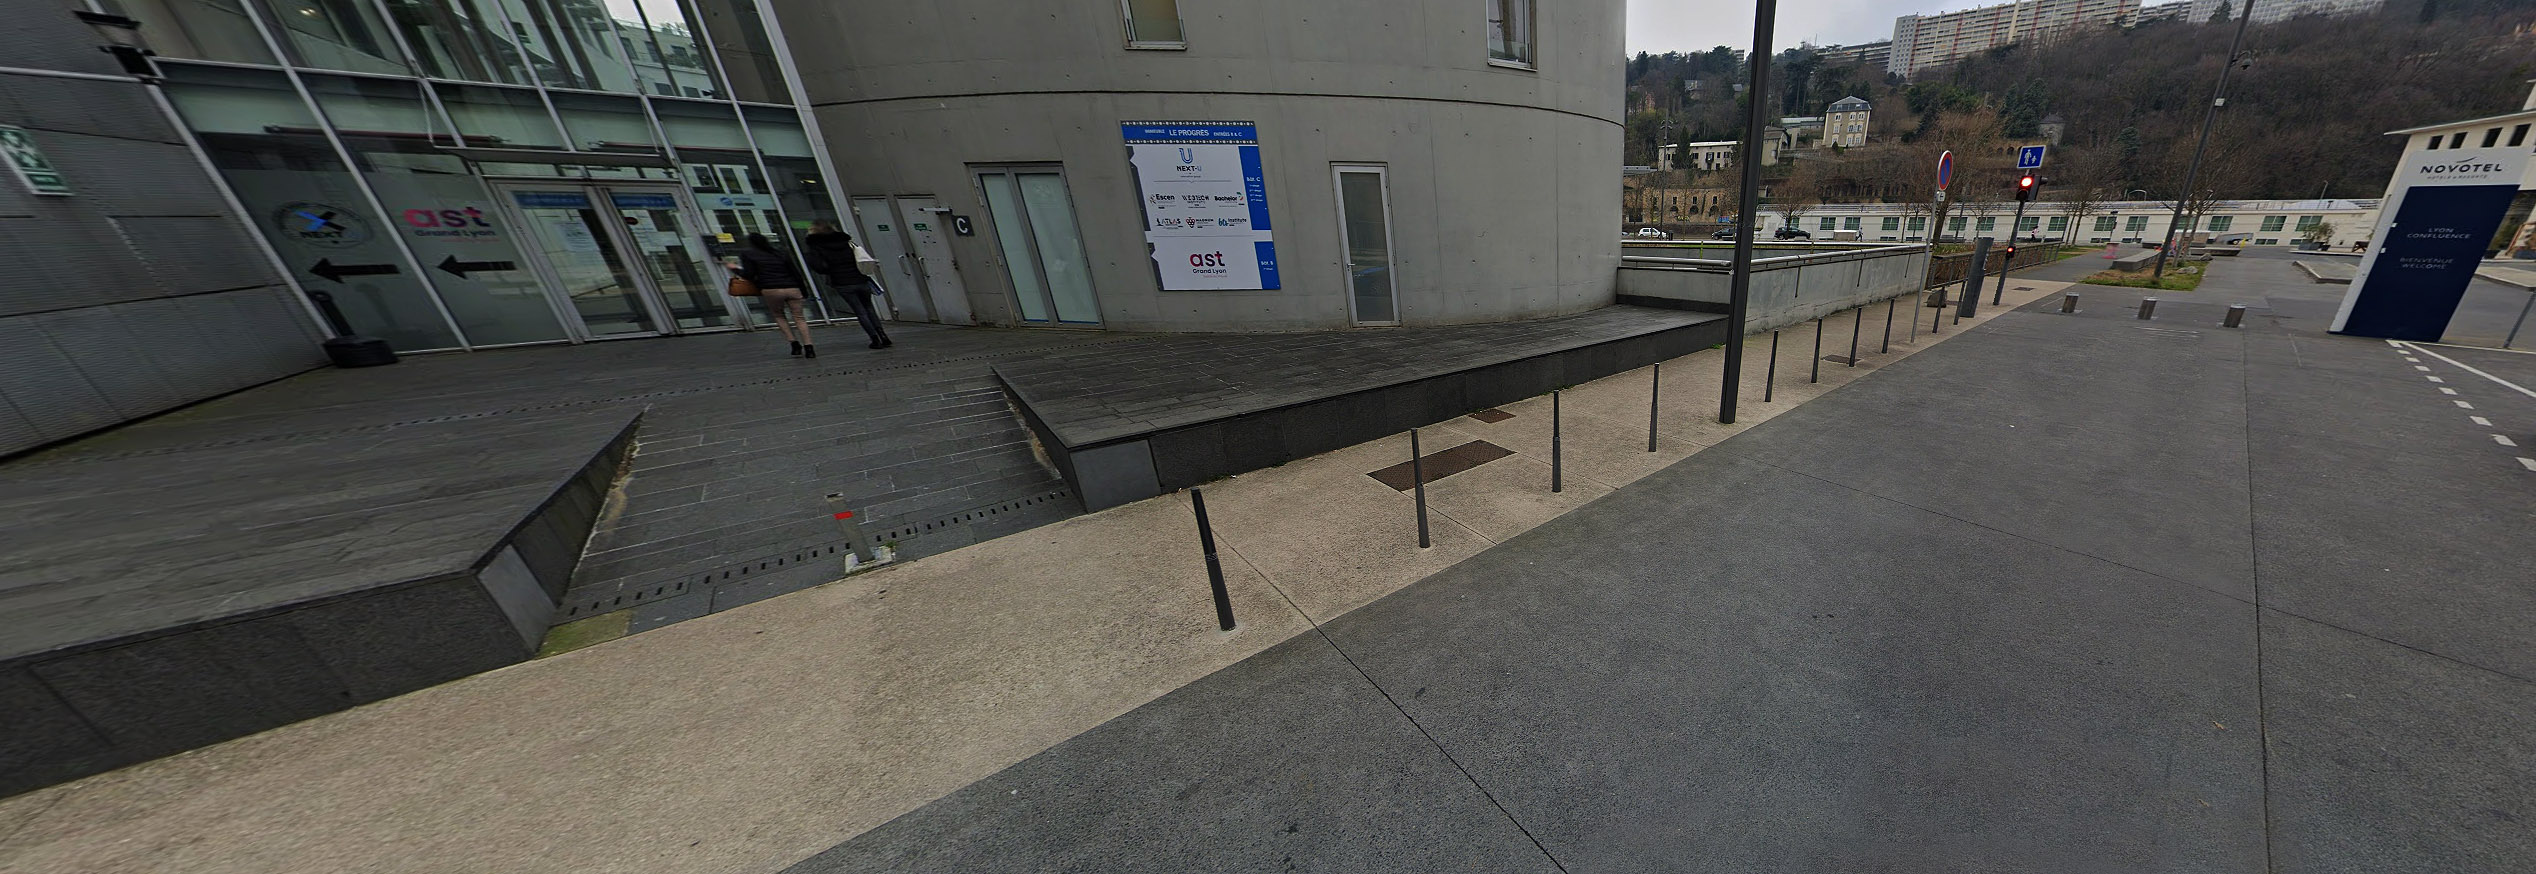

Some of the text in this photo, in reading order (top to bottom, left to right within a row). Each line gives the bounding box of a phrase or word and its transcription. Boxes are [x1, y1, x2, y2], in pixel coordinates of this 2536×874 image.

[2420, 164, 2502, 173] NOVOTEL
[403, 206, 491, 228] ast
[956, 217, 968, 234] C
[462, 230, 496, 238] Lyon
[1189, 251, 1225, 267] ast
